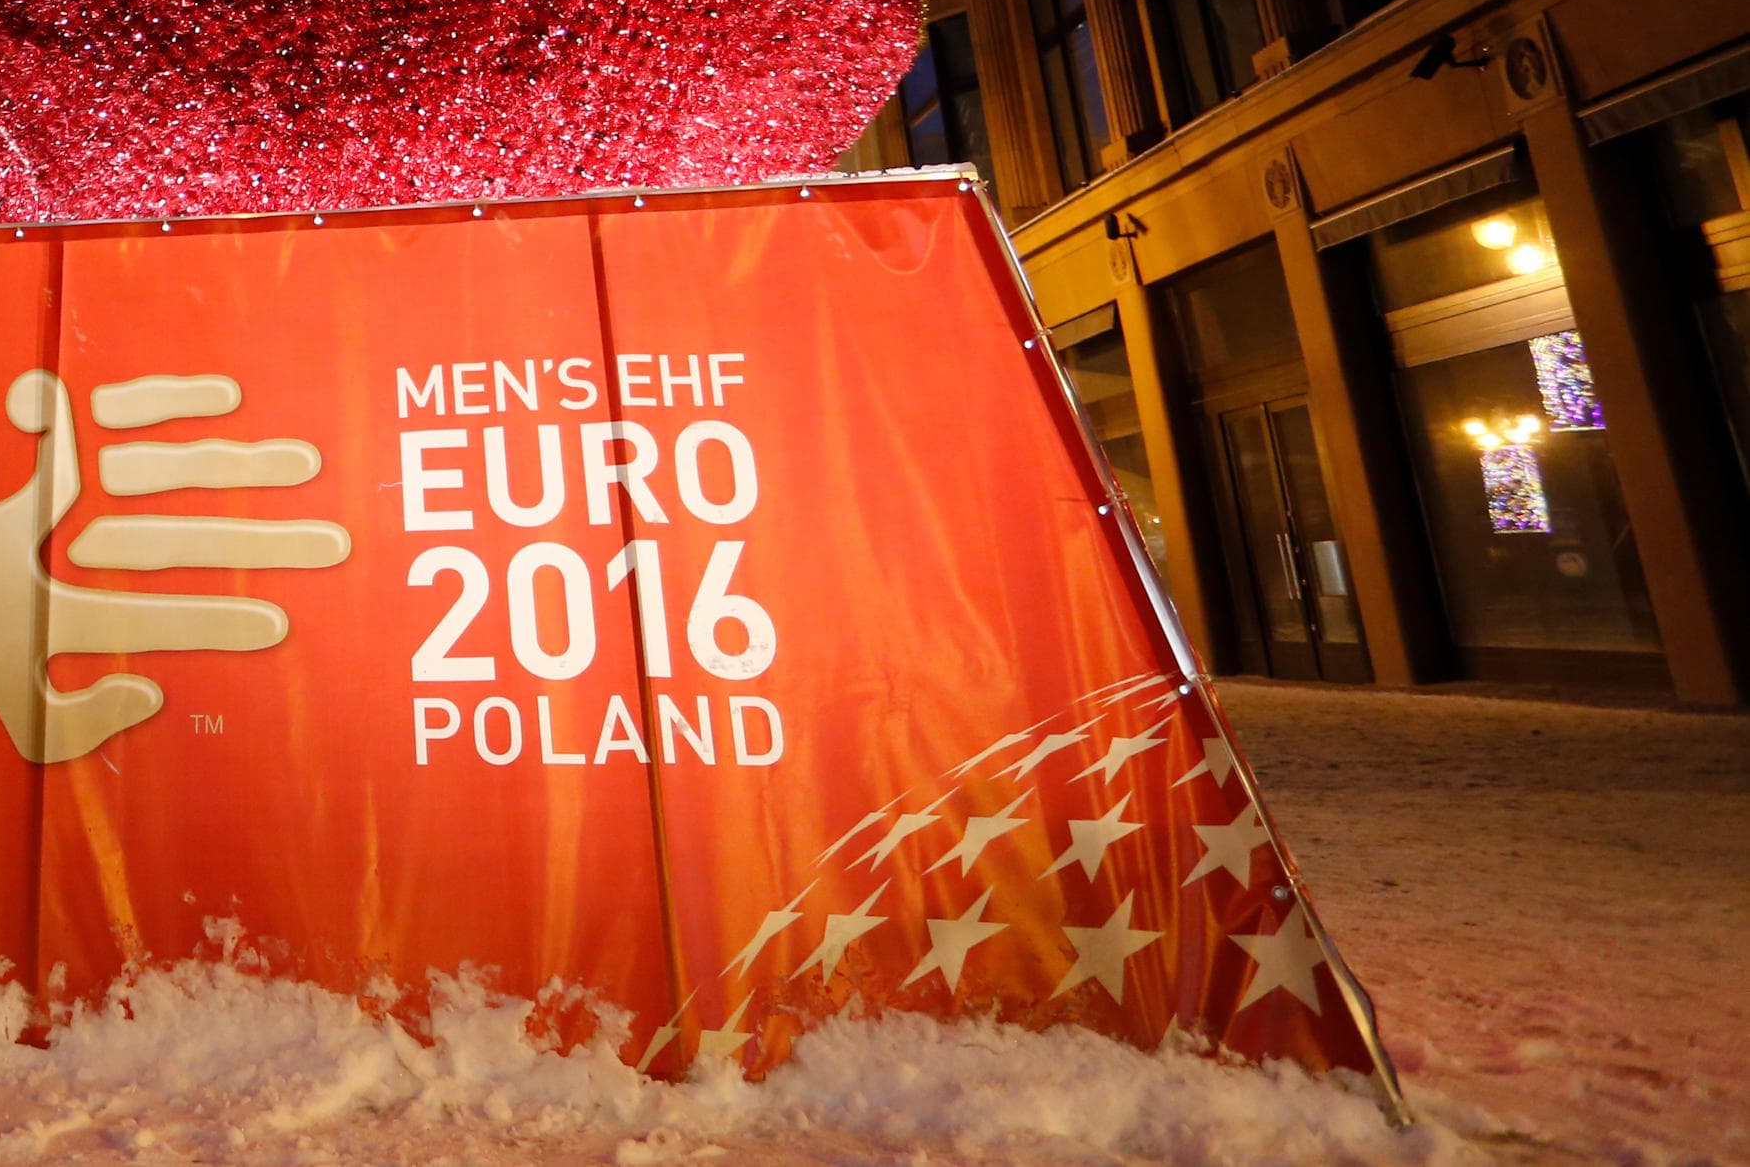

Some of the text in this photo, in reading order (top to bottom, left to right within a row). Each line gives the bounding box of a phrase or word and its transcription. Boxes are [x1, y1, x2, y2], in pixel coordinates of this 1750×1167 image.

[396, 353, 745, 418] MEN'S EHF
[396, 420, 759, 532] EURO
[407, 539, 778, 682] 2016
[190, 714, 224, 734] TM
[413, 694, 785, 766] POLAND
